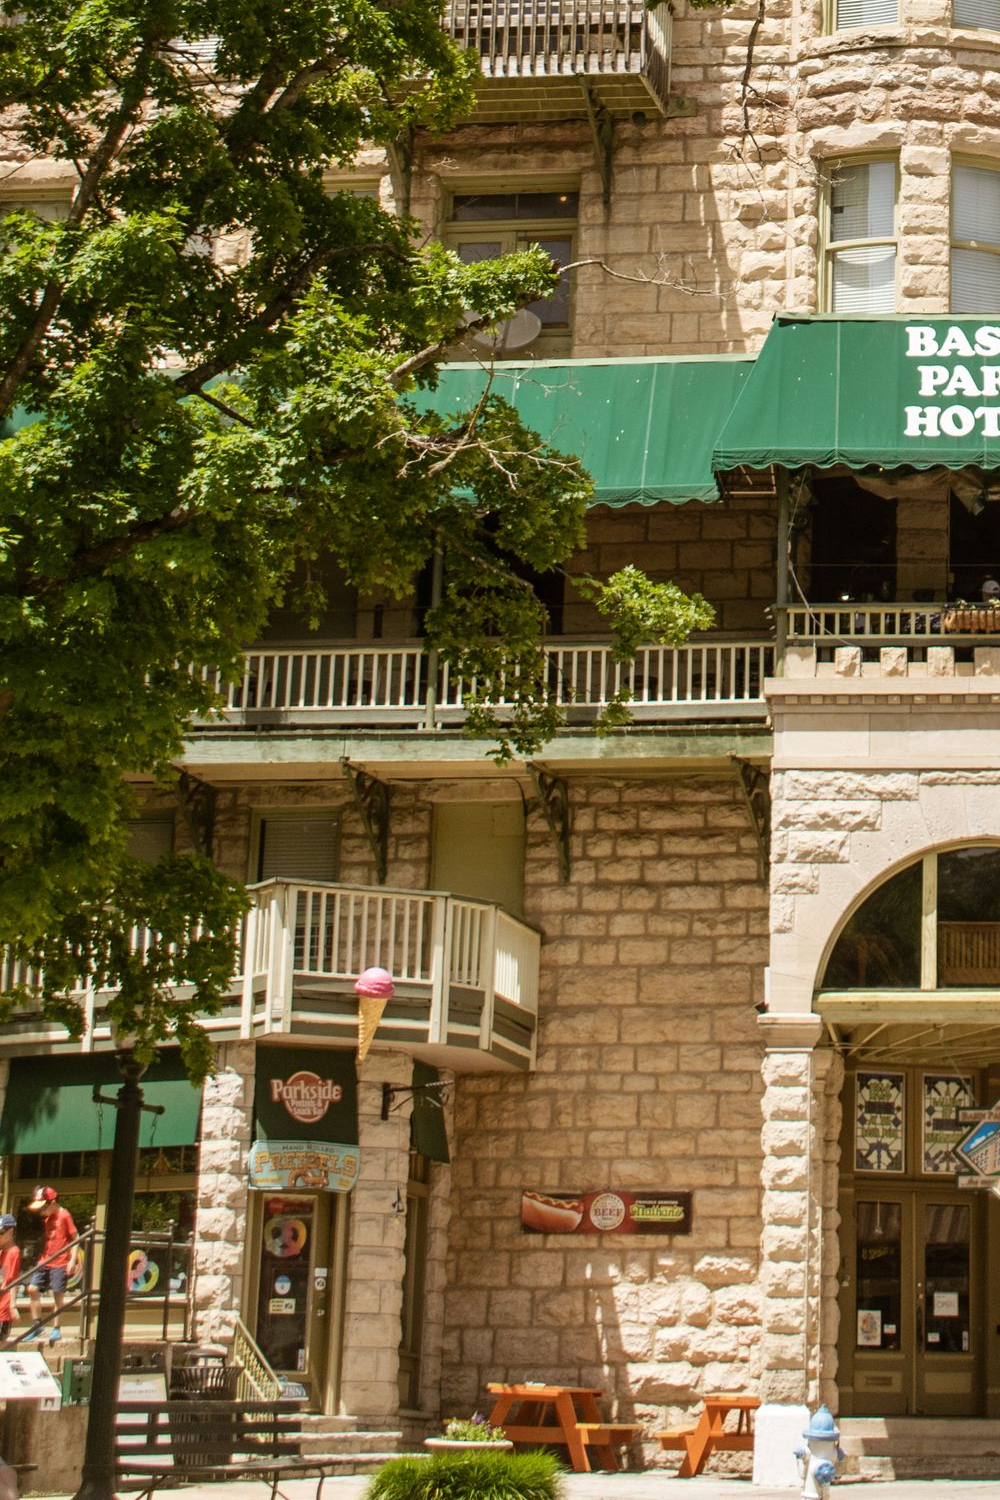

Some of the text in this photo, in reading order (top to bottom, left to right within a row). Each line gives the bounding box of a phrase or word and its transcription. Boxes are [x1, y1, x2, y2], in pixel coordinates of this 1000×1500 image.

[270, 1079, 342, 1101] Parkside
[255, 1151, 358, 1177] PRETZELS
[593, 1208, 624, 1217] BEEF
